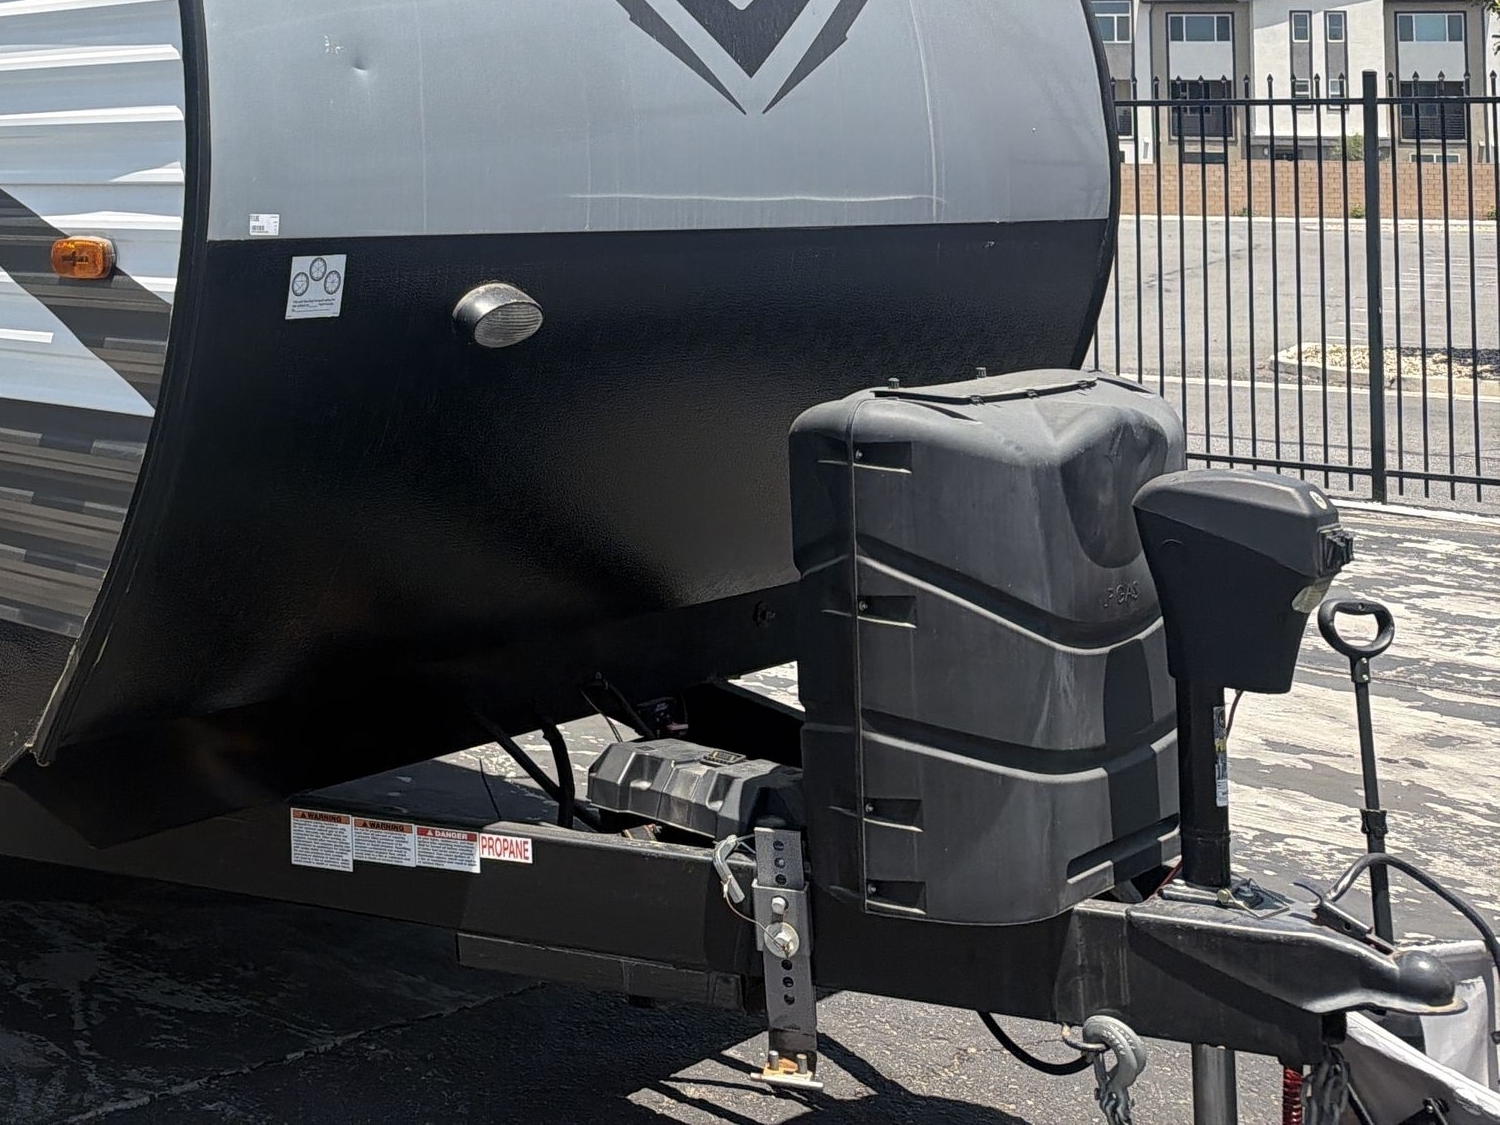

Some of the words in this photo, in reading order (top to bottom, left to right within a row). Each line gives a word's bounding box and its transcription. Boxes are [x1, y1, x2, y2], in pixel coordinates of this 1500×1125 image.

[307, 811, 342, 824] WARNING
[369, 821, 405, 832] WARNING
[434, 830, 469, 841] DANGER
[481, 835, 530, 861] PROPANE
